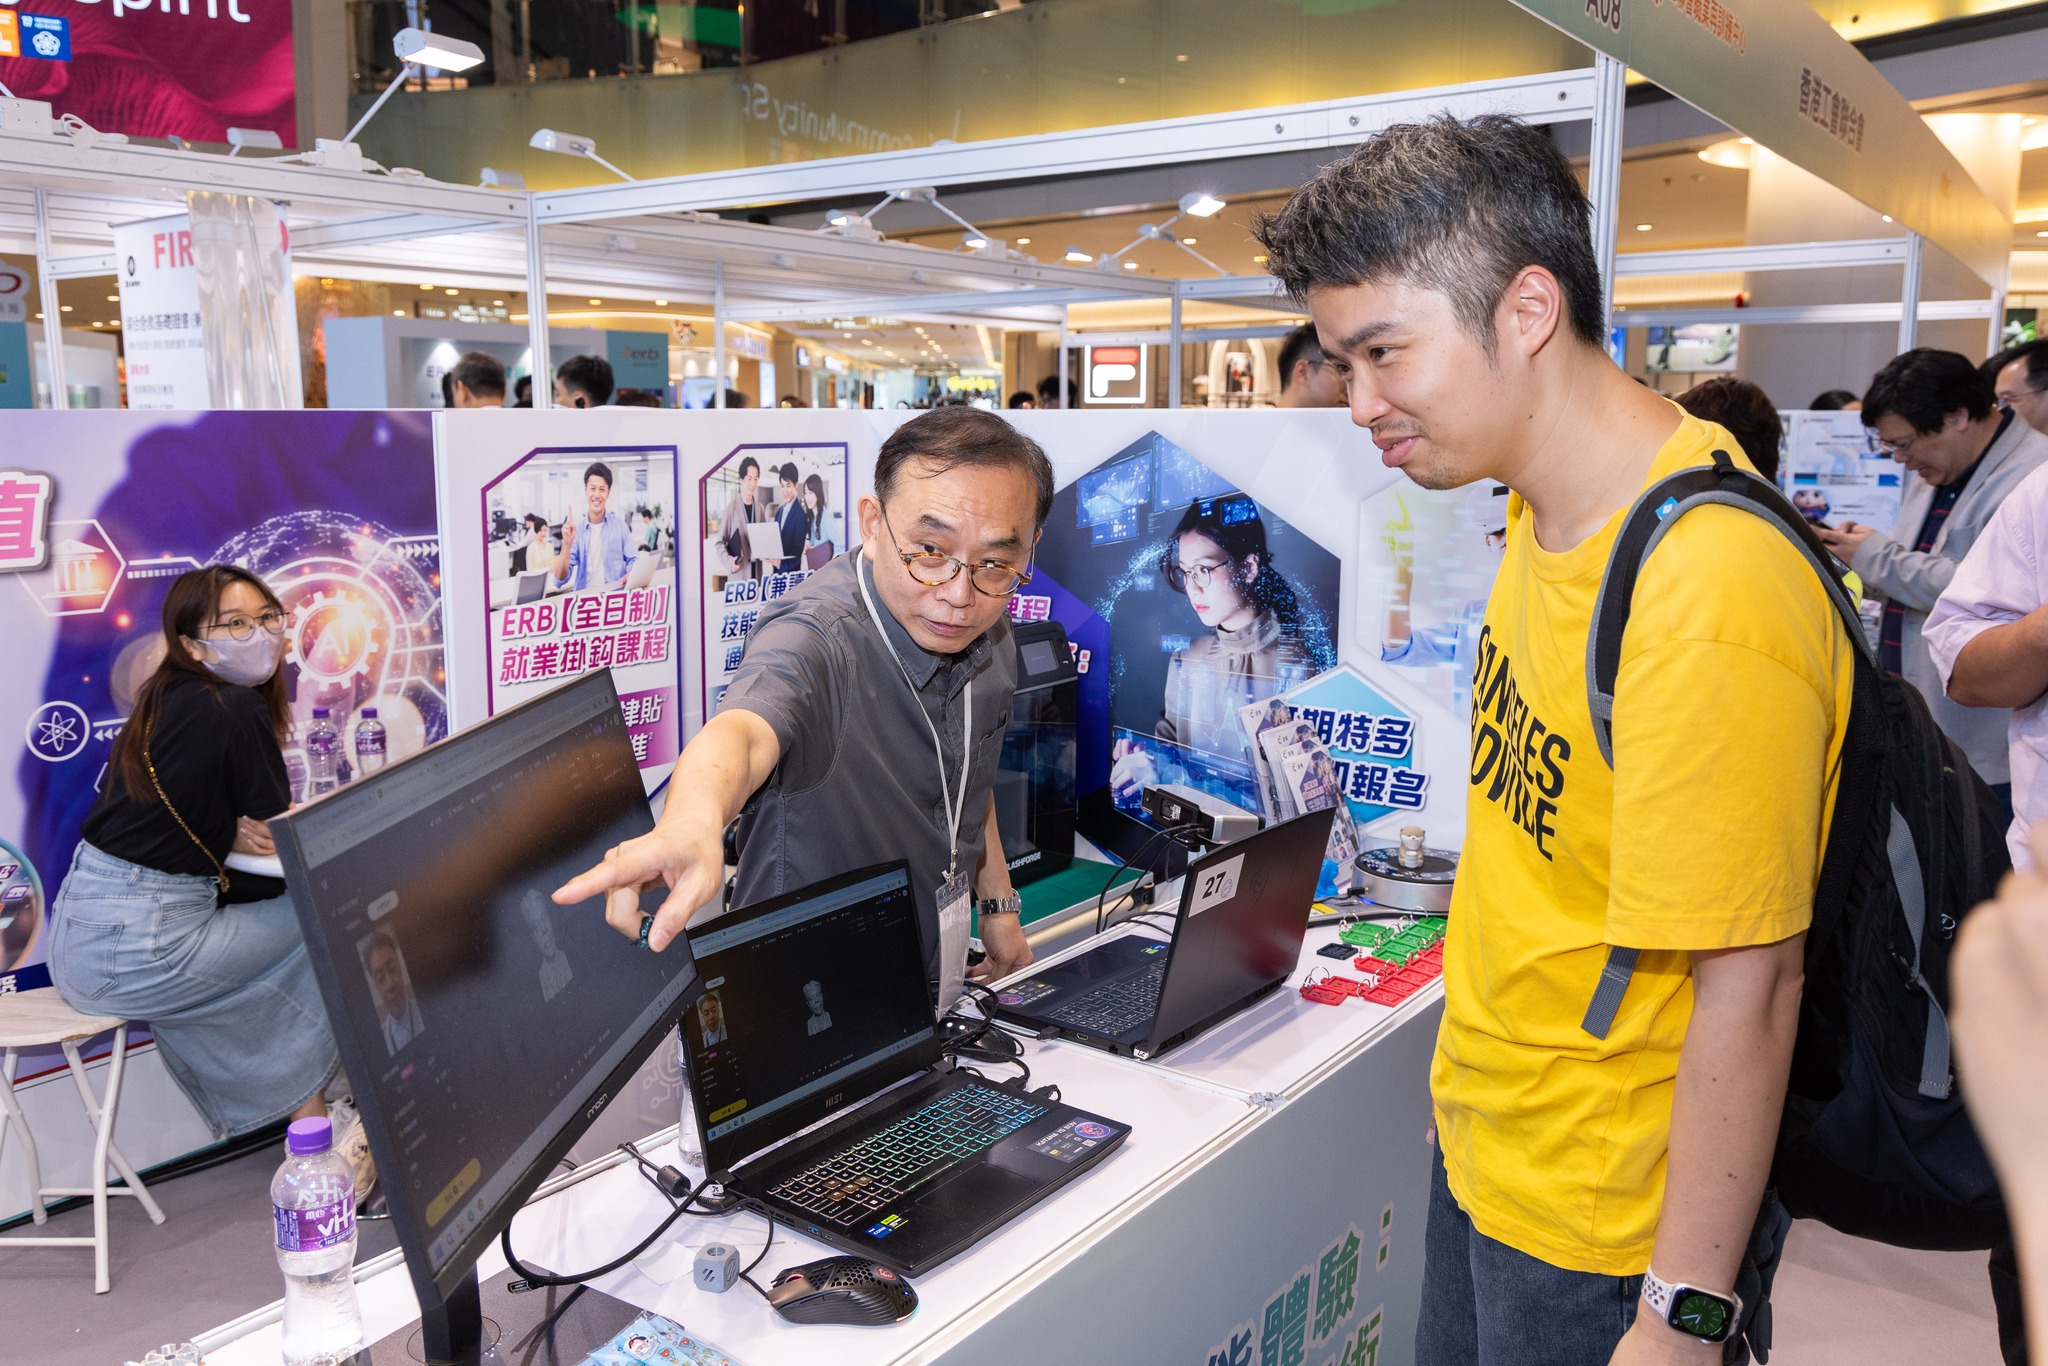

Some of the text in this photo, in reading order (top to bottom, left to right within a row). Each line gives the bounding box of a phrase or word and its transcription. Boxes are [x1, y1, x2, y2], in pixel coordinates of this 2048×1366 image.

[153, 230, 194, 269] FIR
[721, 611, 761, 638] 技能
[1006, 851, 1042, 870] LASHFORGE
[1202, 871, 1227, 900] 27
[825, 1092, 842, 1109] MSI
